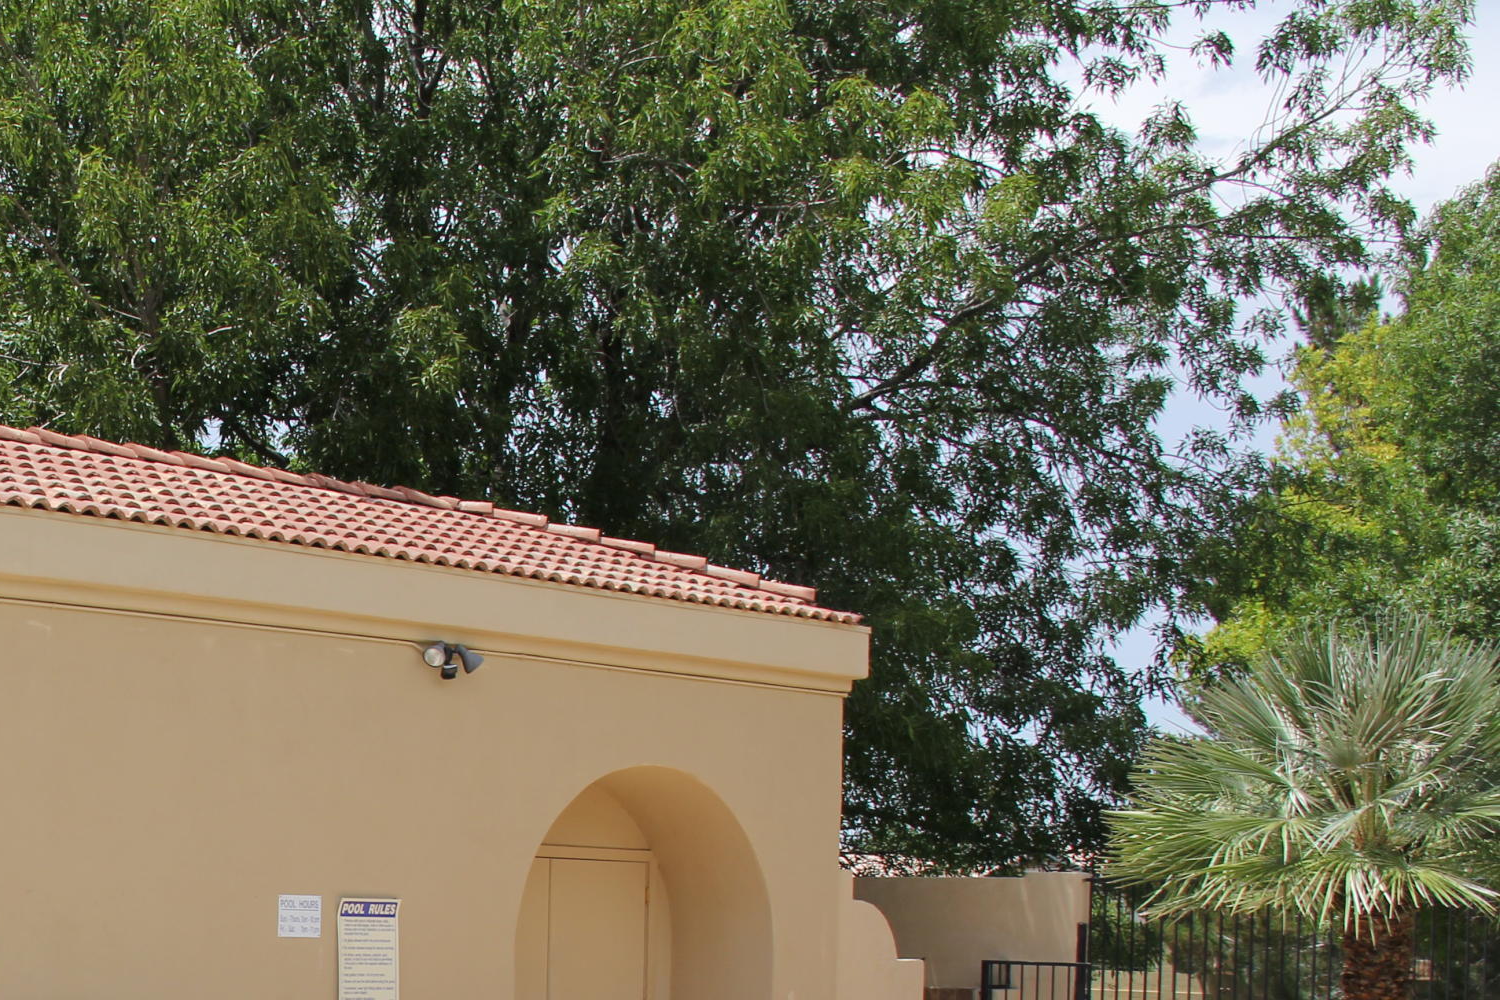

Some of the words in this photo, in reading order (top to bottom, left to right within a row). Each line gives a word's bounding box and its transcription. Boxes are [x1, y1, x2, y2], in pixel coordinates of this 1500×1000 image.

[280, 899, 296, 908] POOL
[299, 899, 319, 909] HOURS
[342, 902, 365, 914] POOL
[368, 903, 396, 915] RULES
